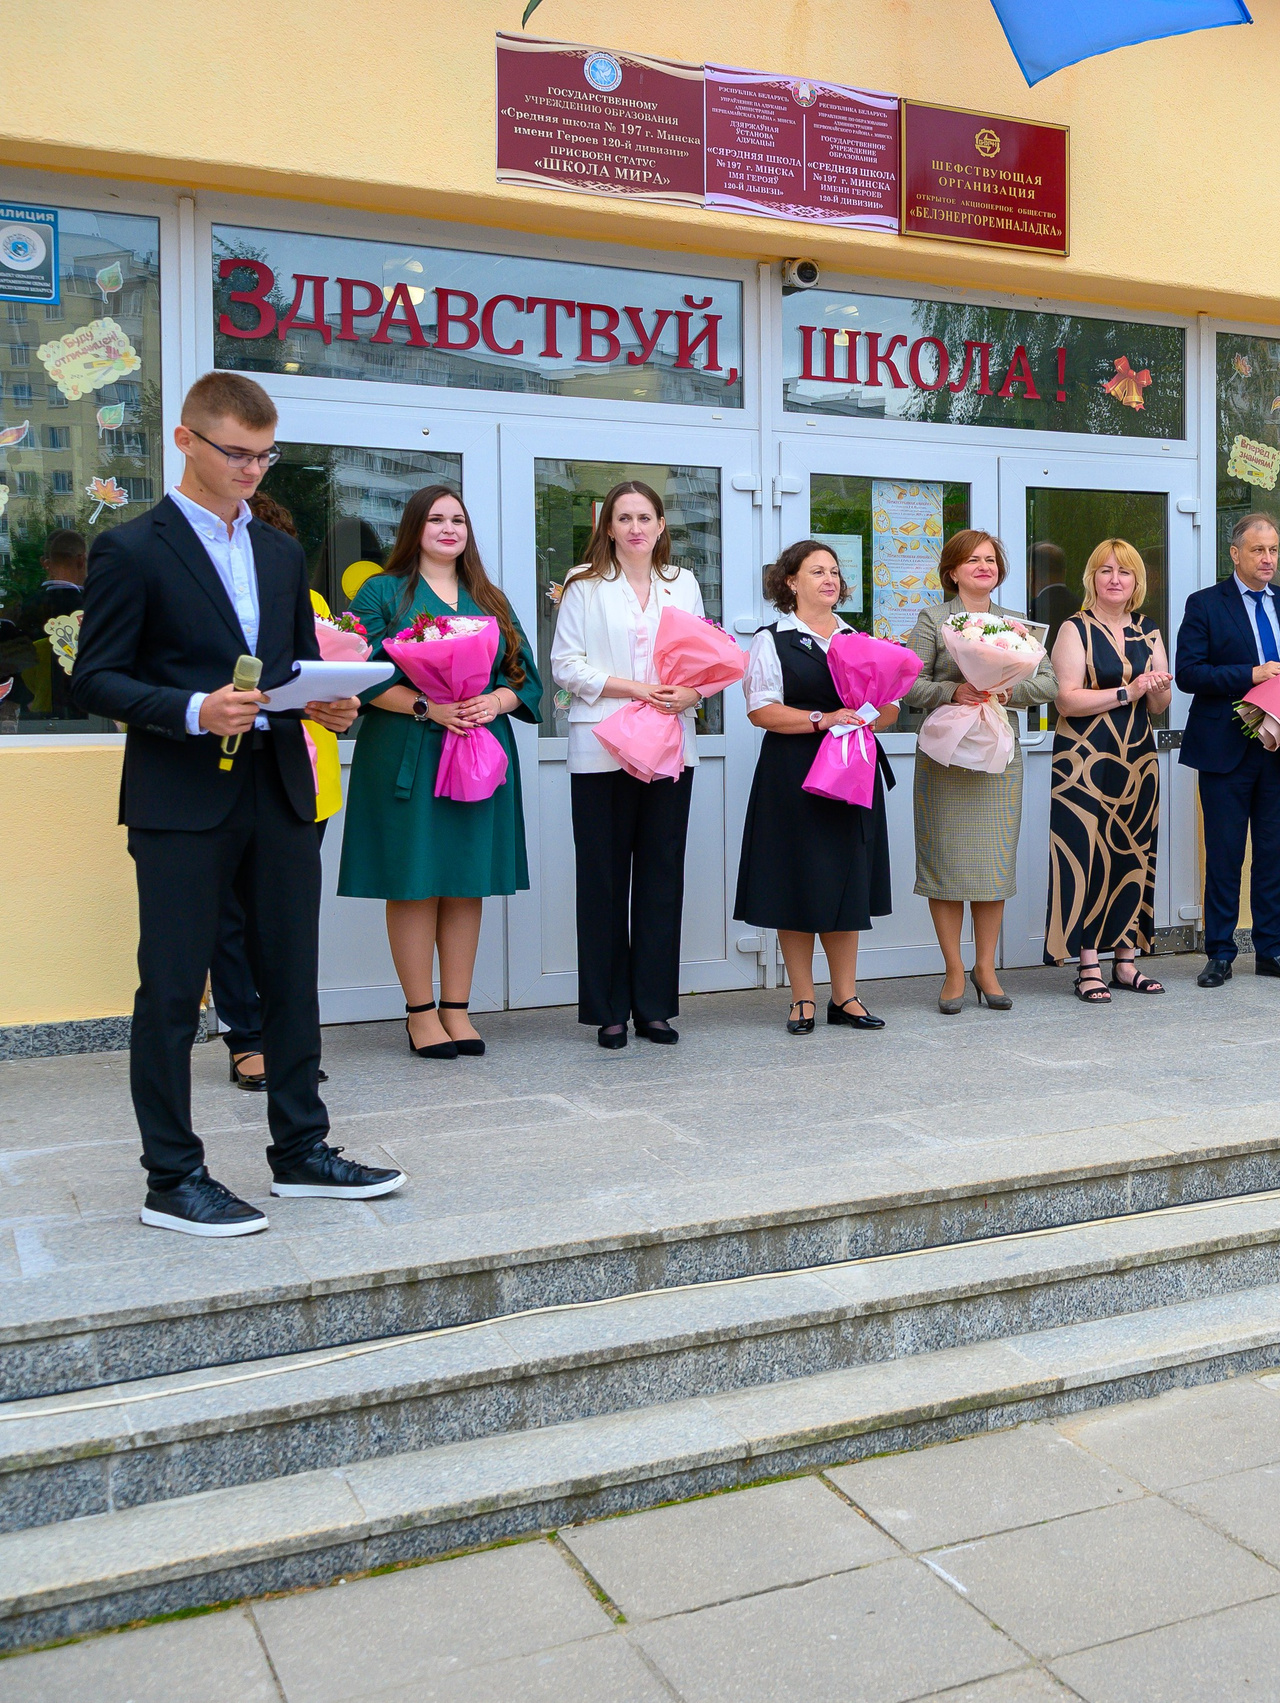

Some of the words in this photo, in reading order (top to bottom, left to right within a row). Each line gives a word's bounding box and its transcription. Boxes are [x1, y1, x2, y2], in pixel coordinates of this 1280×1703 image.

[547, 86, 658, 111] ГОСУДАРСТВЕННОМУ
[758, 92, 790, 102] БЕЛАРУСЬ
[524, 94, 602, 114] УЧРЕЖДЕНИЮ
[604, 107, 679, 126] ОБРАЗОВАНИЯ
[819, 102, 857, 114] РЕСПУБЛИКА
[858, 109, 888, 118] БЕЛАРУСЬ
[500, 106, 559, 124] «Средняя
[562, 117, 600, 130] школа
[604, 121, 617, 132] №
[620, 123, 642, 136] 197
[645, 130, 653, 138] г.
[657, 130, 701, 145] Минска
[730, 120, 779, 134] ДЗЯРЖАЎНАЯ
[514, 126, 553, 138] имени
[556, 130, 598, 145] Героев
[602, 137, 632, 150] 120-й
[635, 143, 689, 158] дивизии»
[736, 136, 775, 148] АДУКАЦЫІ
[820, 135, 886, 151] ГОСУДАРСТВЕННОЕ
[830, 143, 877, 157] УЧРЕЖДЕНИЕ
[550, 145, 612, 162] ПРИСВОЕН
[614, 155, 656, 168] СТАТУС
[707, 146, 764, 162] «СЯРЭДНЯЯ
[766, 153, 802, 167] ШКОЛА
[829, 151, 878, 164] ОБРАЗОВАНИЯ
[534, 157, 610, 178] «ШКОЛА
[614, 167, 671, 186] МИРА»
[716, 158, 725, 168] №
[727, 160, 741, 170] 197
[755, 164, 795, 178] МІНСКА
[728, 171, 744, 180] ІМЯ
[746, 173, 779, 185] ГЕРОЯЎ
[807, 161, 858, 176] «СРЕДНЯЯ
[860, 168, 896, 181] ШКОЛА
[931, 159, 1042, 186] ШЕФСТВУЮЩАЯ
[723, 181, 744, 192] 120-Й
[813, 172, 822, 182] №
[823, 174, 837, 184] 197
[850, 177, 891, 191] МИНСКА
[820, 184, 850, 194] ИМЕНИ
[852, 188, 882, 199] ГЕРОЕВ
[938, 176, 1036, 200] ОРГАНИЗАЦИЯ
[819, 194, 839, 204] 120-Й
[840, 197, 884, 209] ДИВИЗИИ»
[916, 193, 956, 205] ОТКРЫТОЕ
[961, 200, 1014, 213] АКЦИОНЕРНОЕ
[1017, 207, 1057, 219] ОБЩЕСТВО
[909, 205, 1063, 237] «БЕЛЭНЕРГОРЕМНАЛАДКА»
[218, 258, 739, 387] ЗДРАВСТВУЙ,
[54, 330, 119, 368] отличницей!
[63, 330, 94, 349] Буду
[1240, 438, 1270, 459] Вперёд
[1239, 451, 1274, 470] знаниям!
